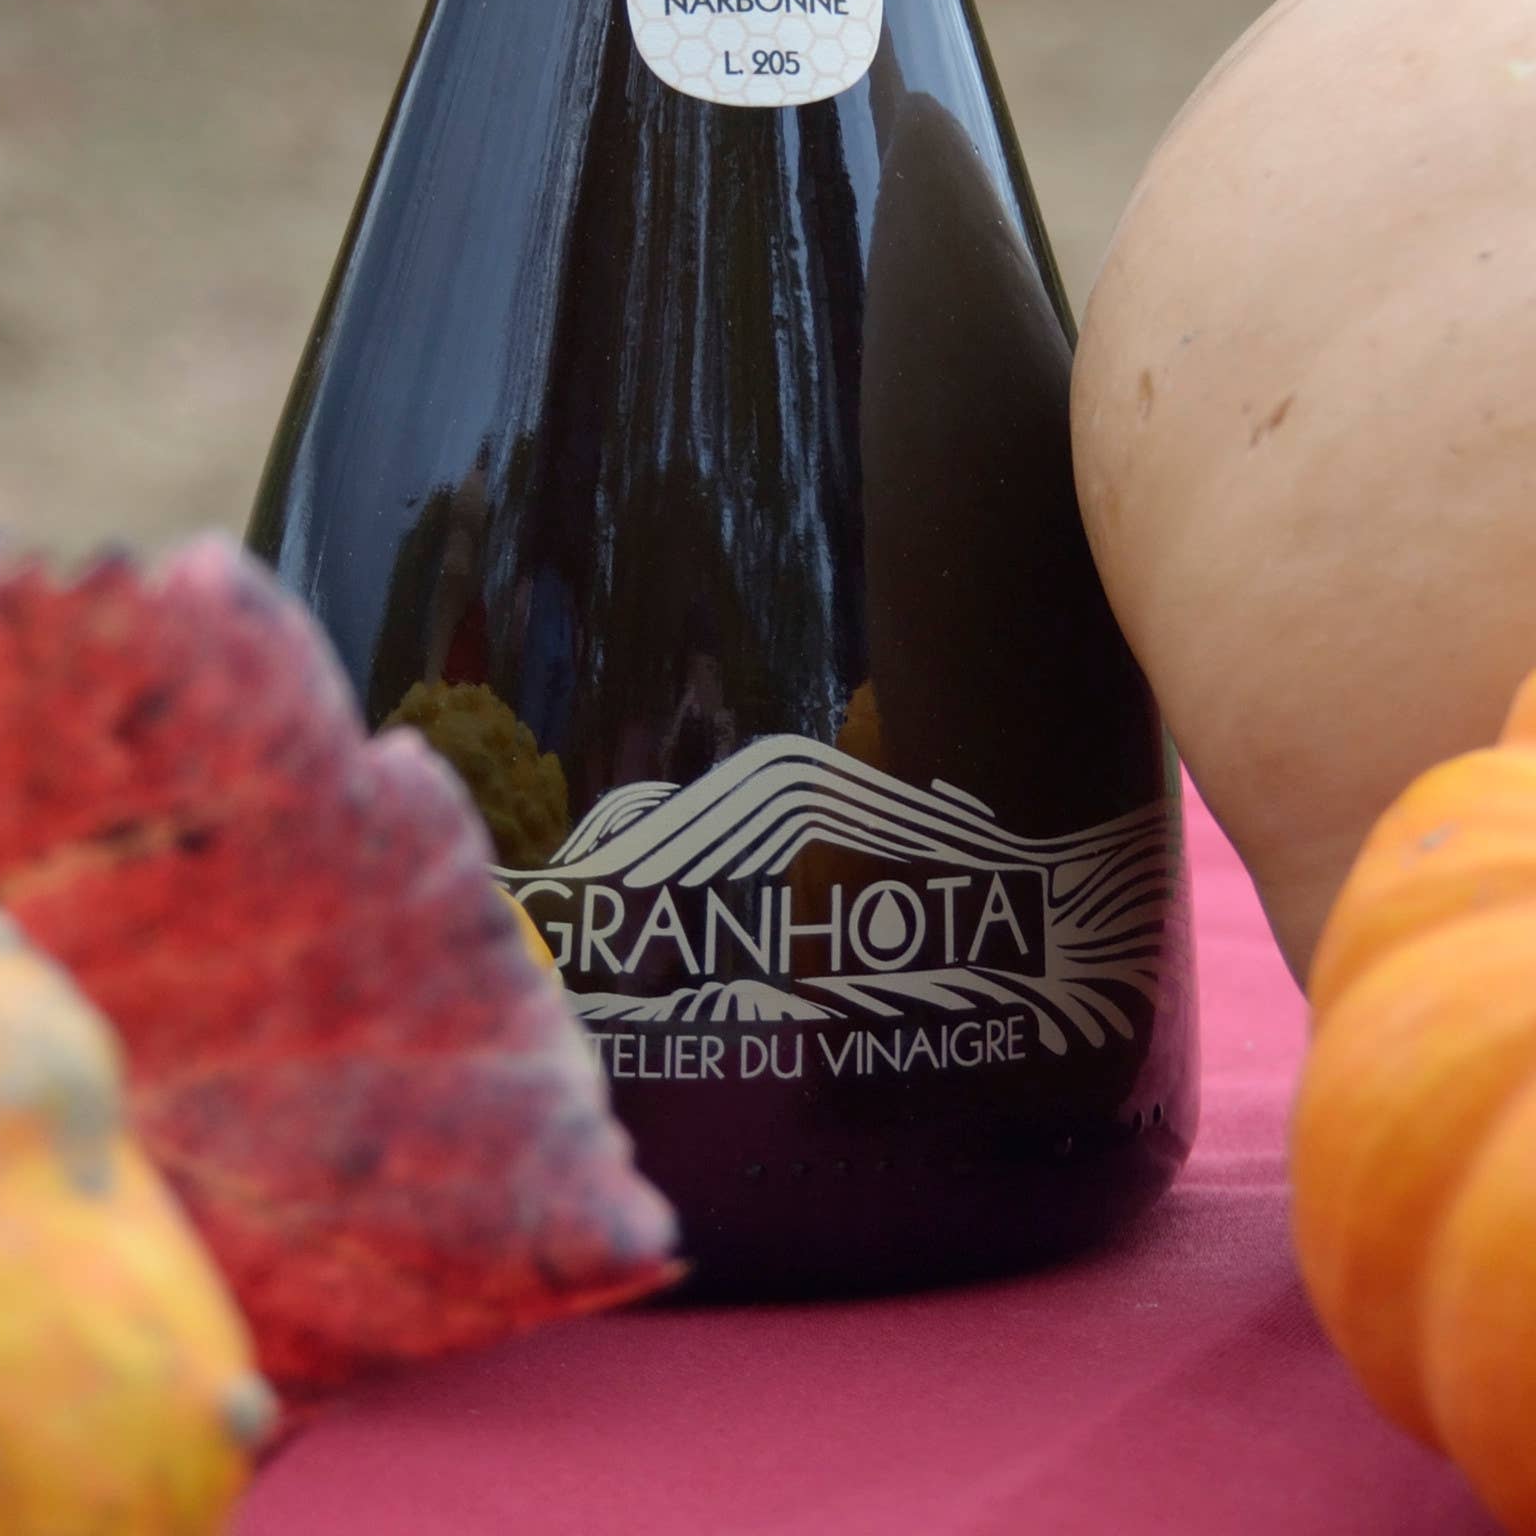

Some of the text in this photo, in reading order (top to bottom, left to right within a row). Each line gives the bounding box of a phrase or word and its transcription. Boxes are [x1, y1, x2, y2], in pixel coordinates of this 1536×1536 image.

[724, 49, 801, 75] L. 205
[513, 870, 1029, 975] GRANHOTA
[586, 1015, 1026, 1080] TELIER DU VINAIGRE
